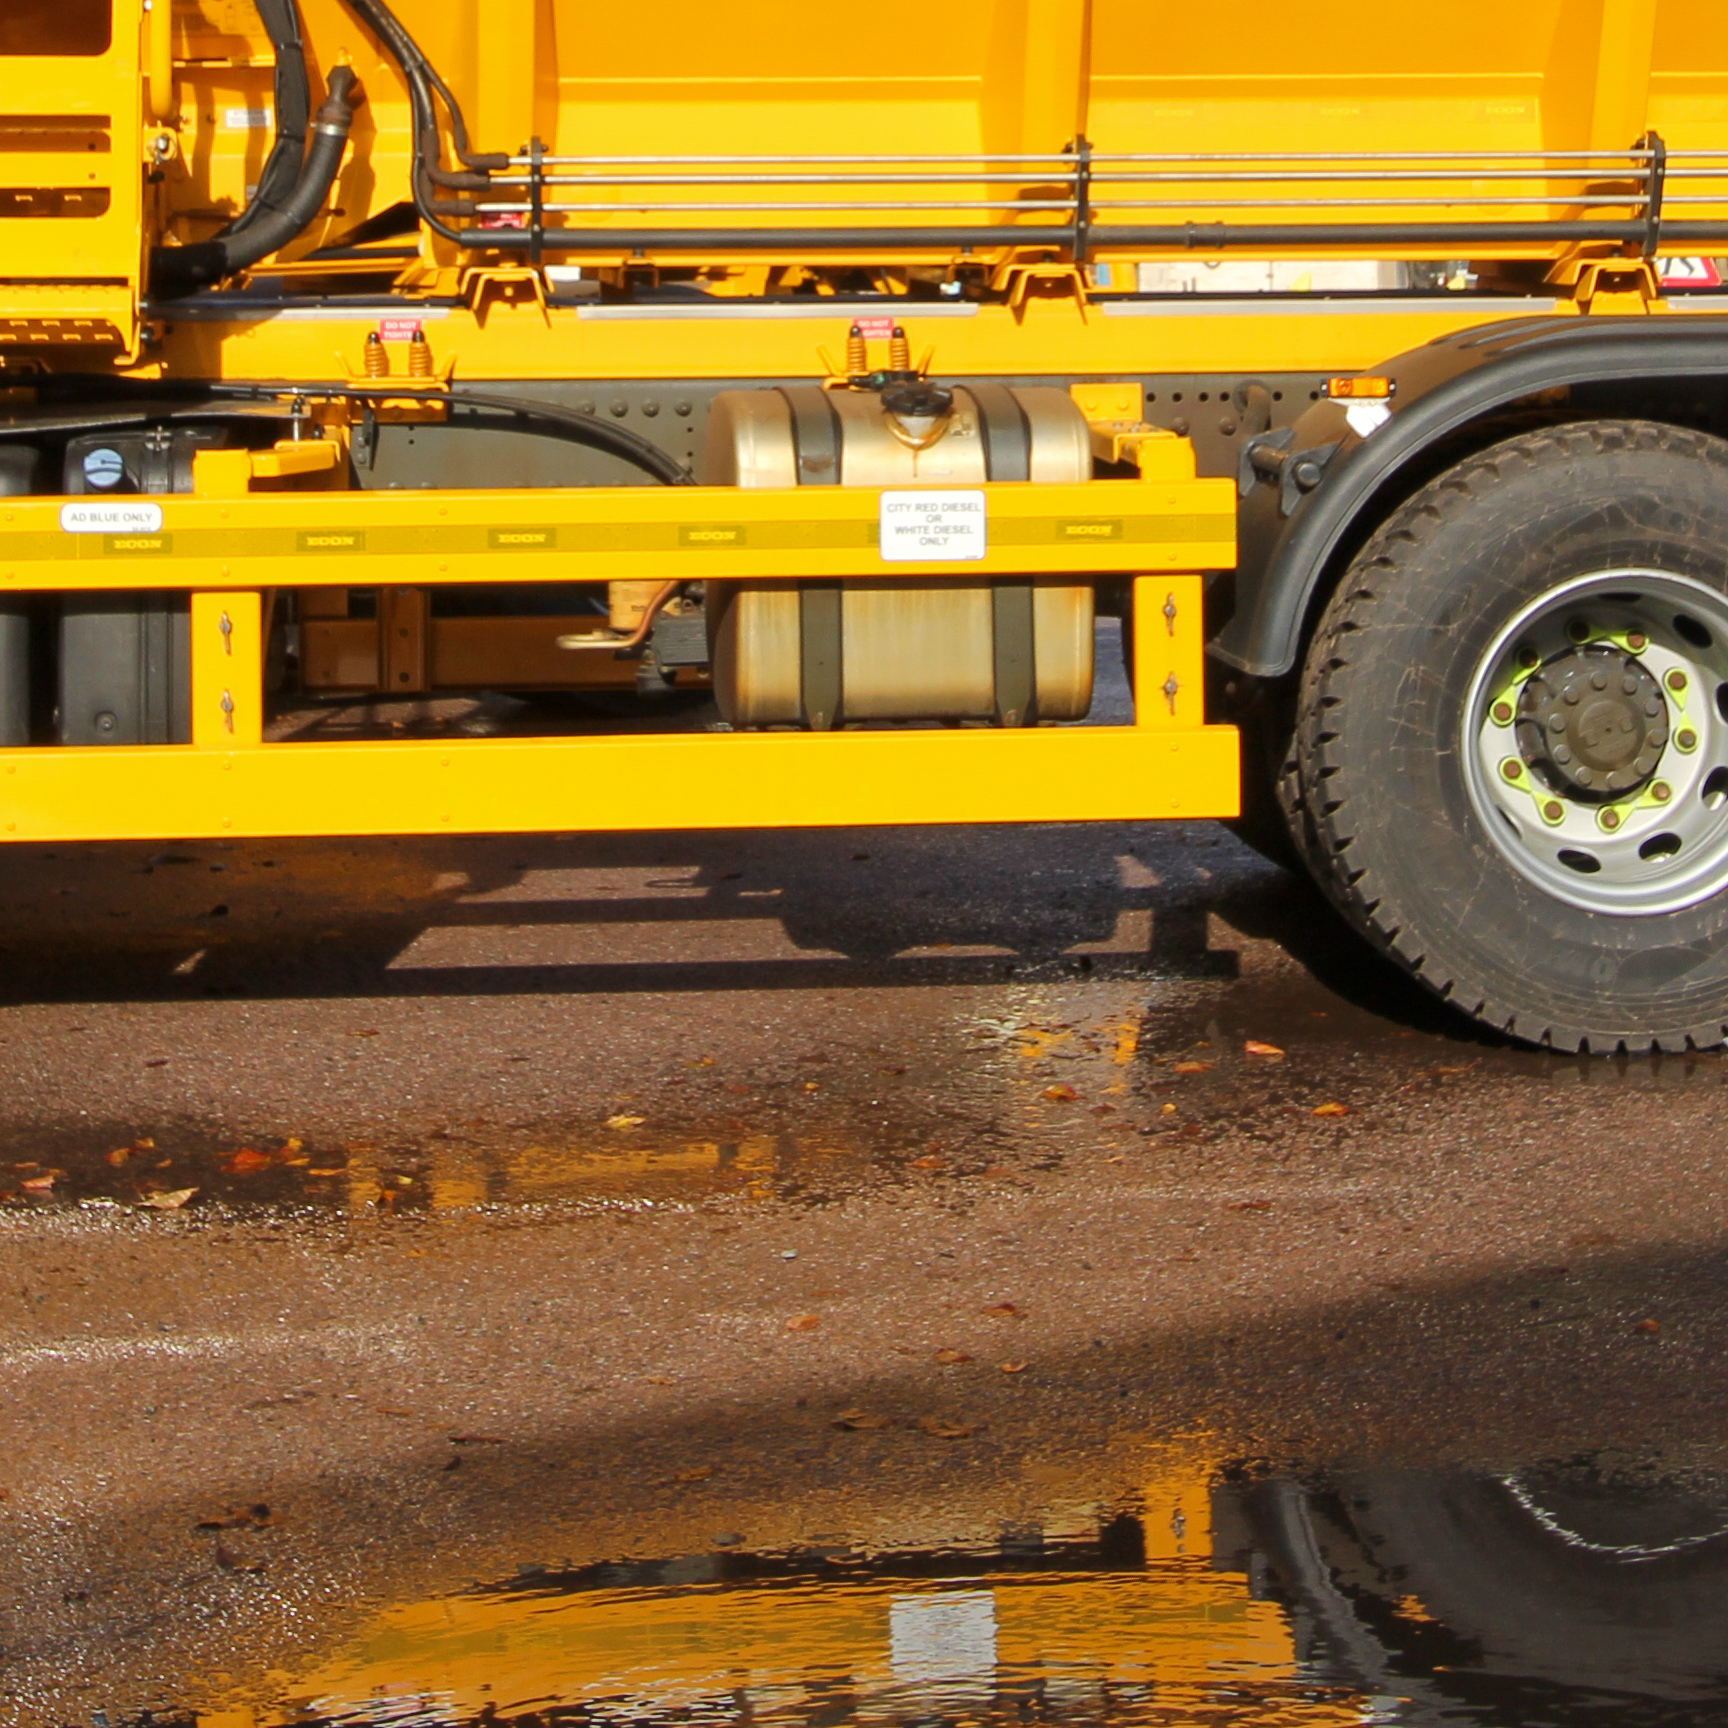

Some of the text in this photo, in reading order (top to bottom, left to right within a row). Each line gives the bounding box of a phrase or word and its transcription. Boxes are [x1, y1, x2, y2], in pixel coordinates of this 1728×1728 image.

[886, 502, 981, 513] CITY RED DIESEL
[70, 512, 153, 522] AD BLUE ONLY
[925, 514, 943, 523] OR
[894, 525, 974, 535] WHITE DIESEL
[919, 537, 950, 547] ONLY
